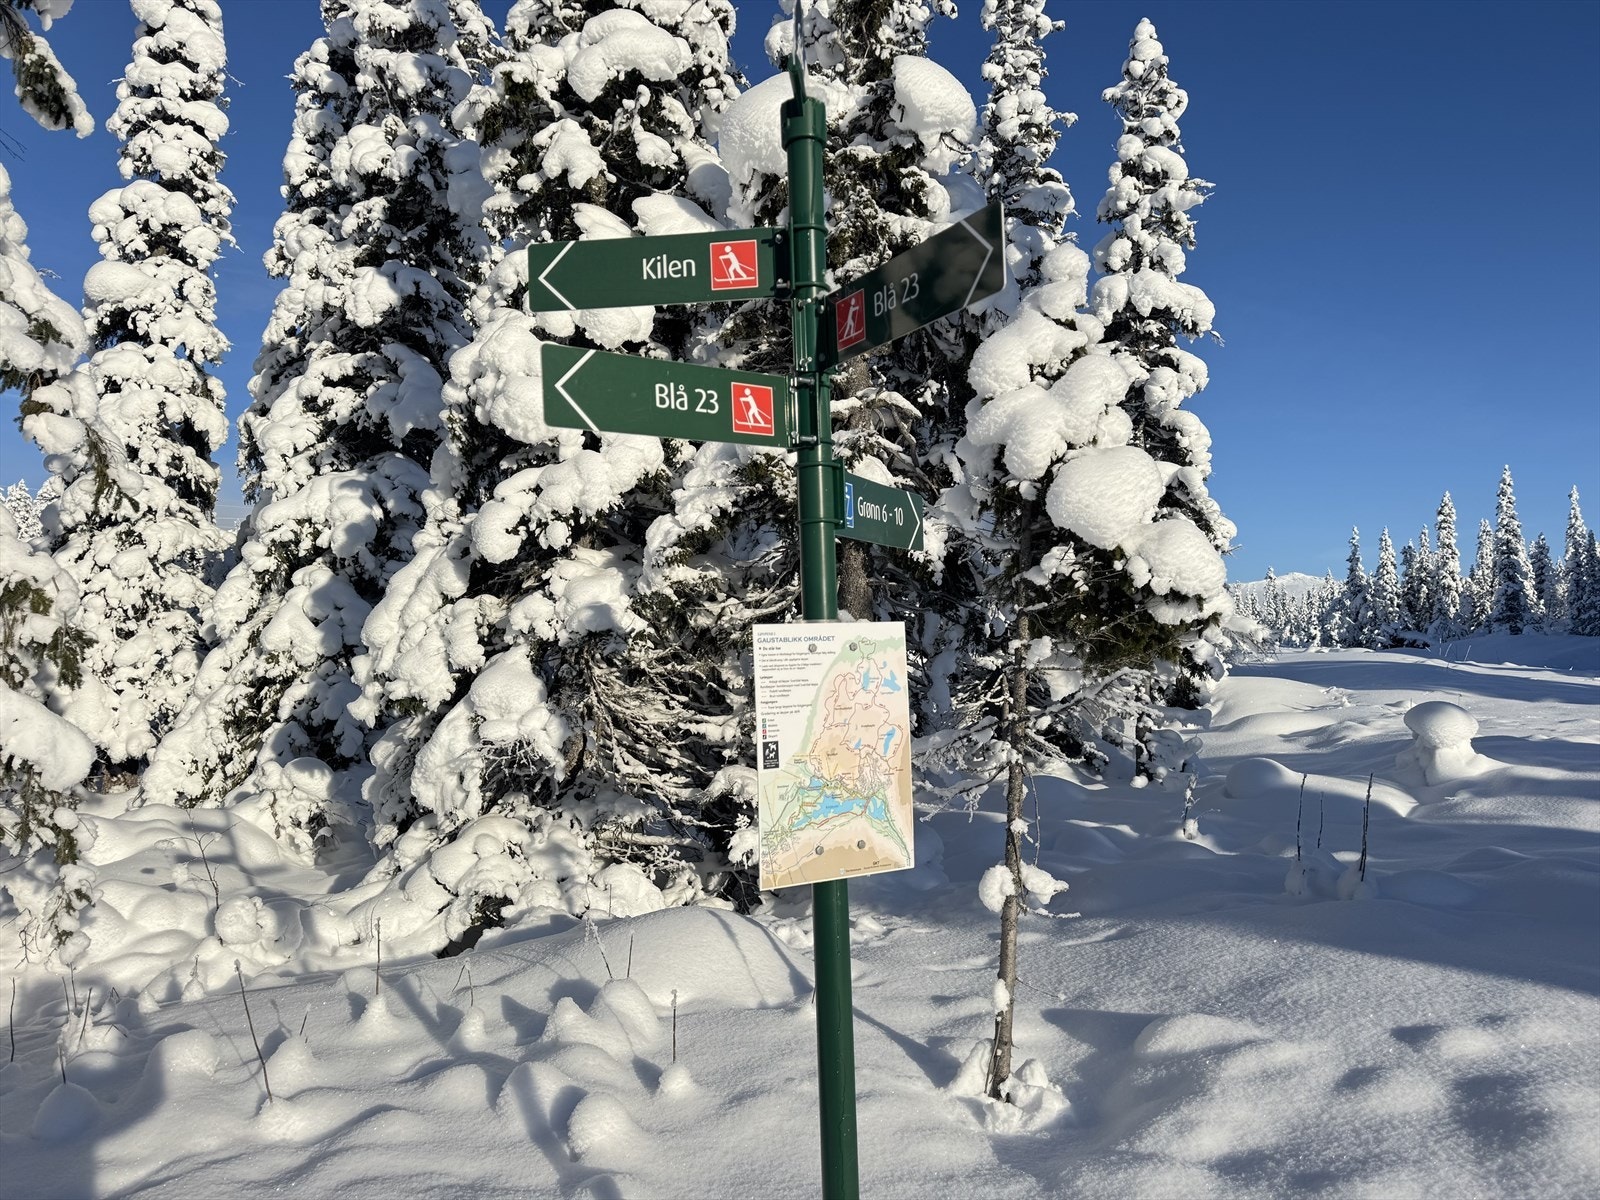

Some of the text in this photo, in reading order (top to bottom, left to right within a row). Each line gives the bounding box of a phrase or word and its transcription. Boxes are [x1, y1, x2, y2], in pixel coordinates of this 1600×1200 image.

[642, 254, 696, 281] Kilen
[873, 272, 920, 317] Blå 23
[655, 382, 719, 414] Blå 23
[857, 496, 880, 521] Grønn
[882, 504, 888, 523] 6
[894, 507, 904, 526] 10
